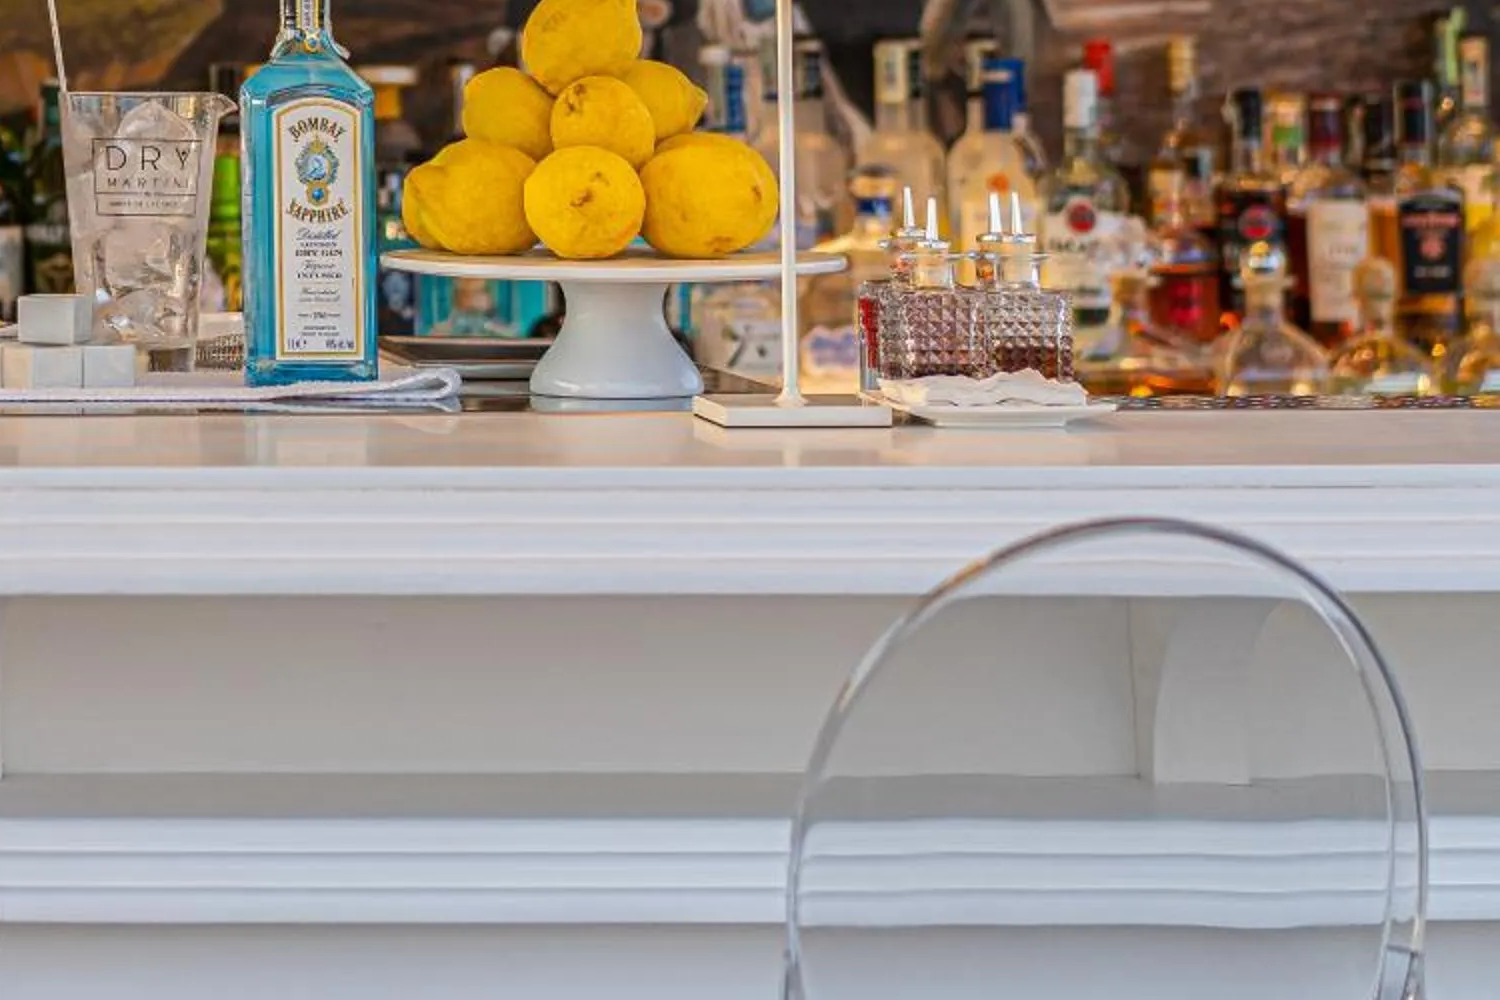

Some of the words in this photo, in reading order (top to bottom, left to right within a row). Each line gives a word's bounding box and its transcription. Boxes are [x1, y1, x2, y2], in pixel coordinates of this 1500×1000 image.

[288, 117, 345, 142] BOMBAY
[105, 145, 190, 170] DRY
[107, 177, 189, 189] MARTINI
[286, 198, 350, 222] SAPPHIRE
